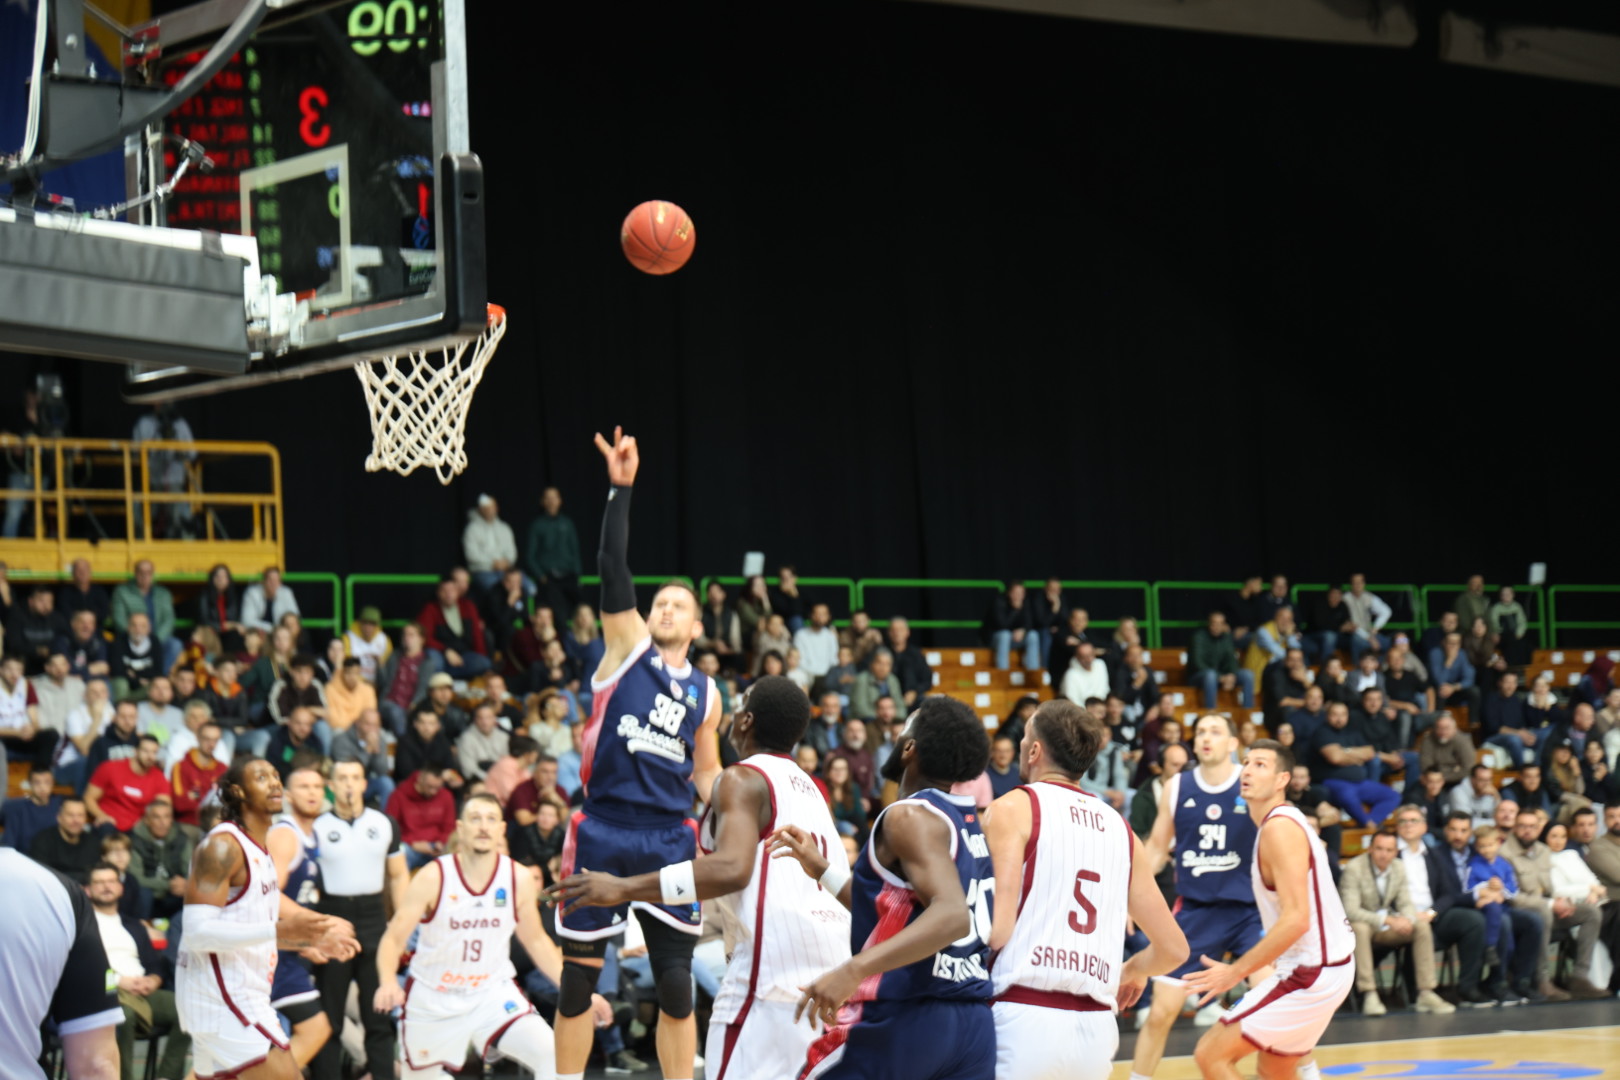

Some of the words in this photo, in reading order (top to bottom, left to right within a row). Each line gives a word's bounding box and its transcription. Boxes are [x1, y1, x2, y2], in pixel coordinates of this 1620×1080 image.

[649, 693, 686, 736] 38
[1069, 805, 1105, 832] ATIĆ
[1198, 824, 1226, 850] 34
[1068, 869, 1101, 935] 5
[462, 939, 483, 962] 19
[1031, 945, 1110, 984] SARAJEVO
